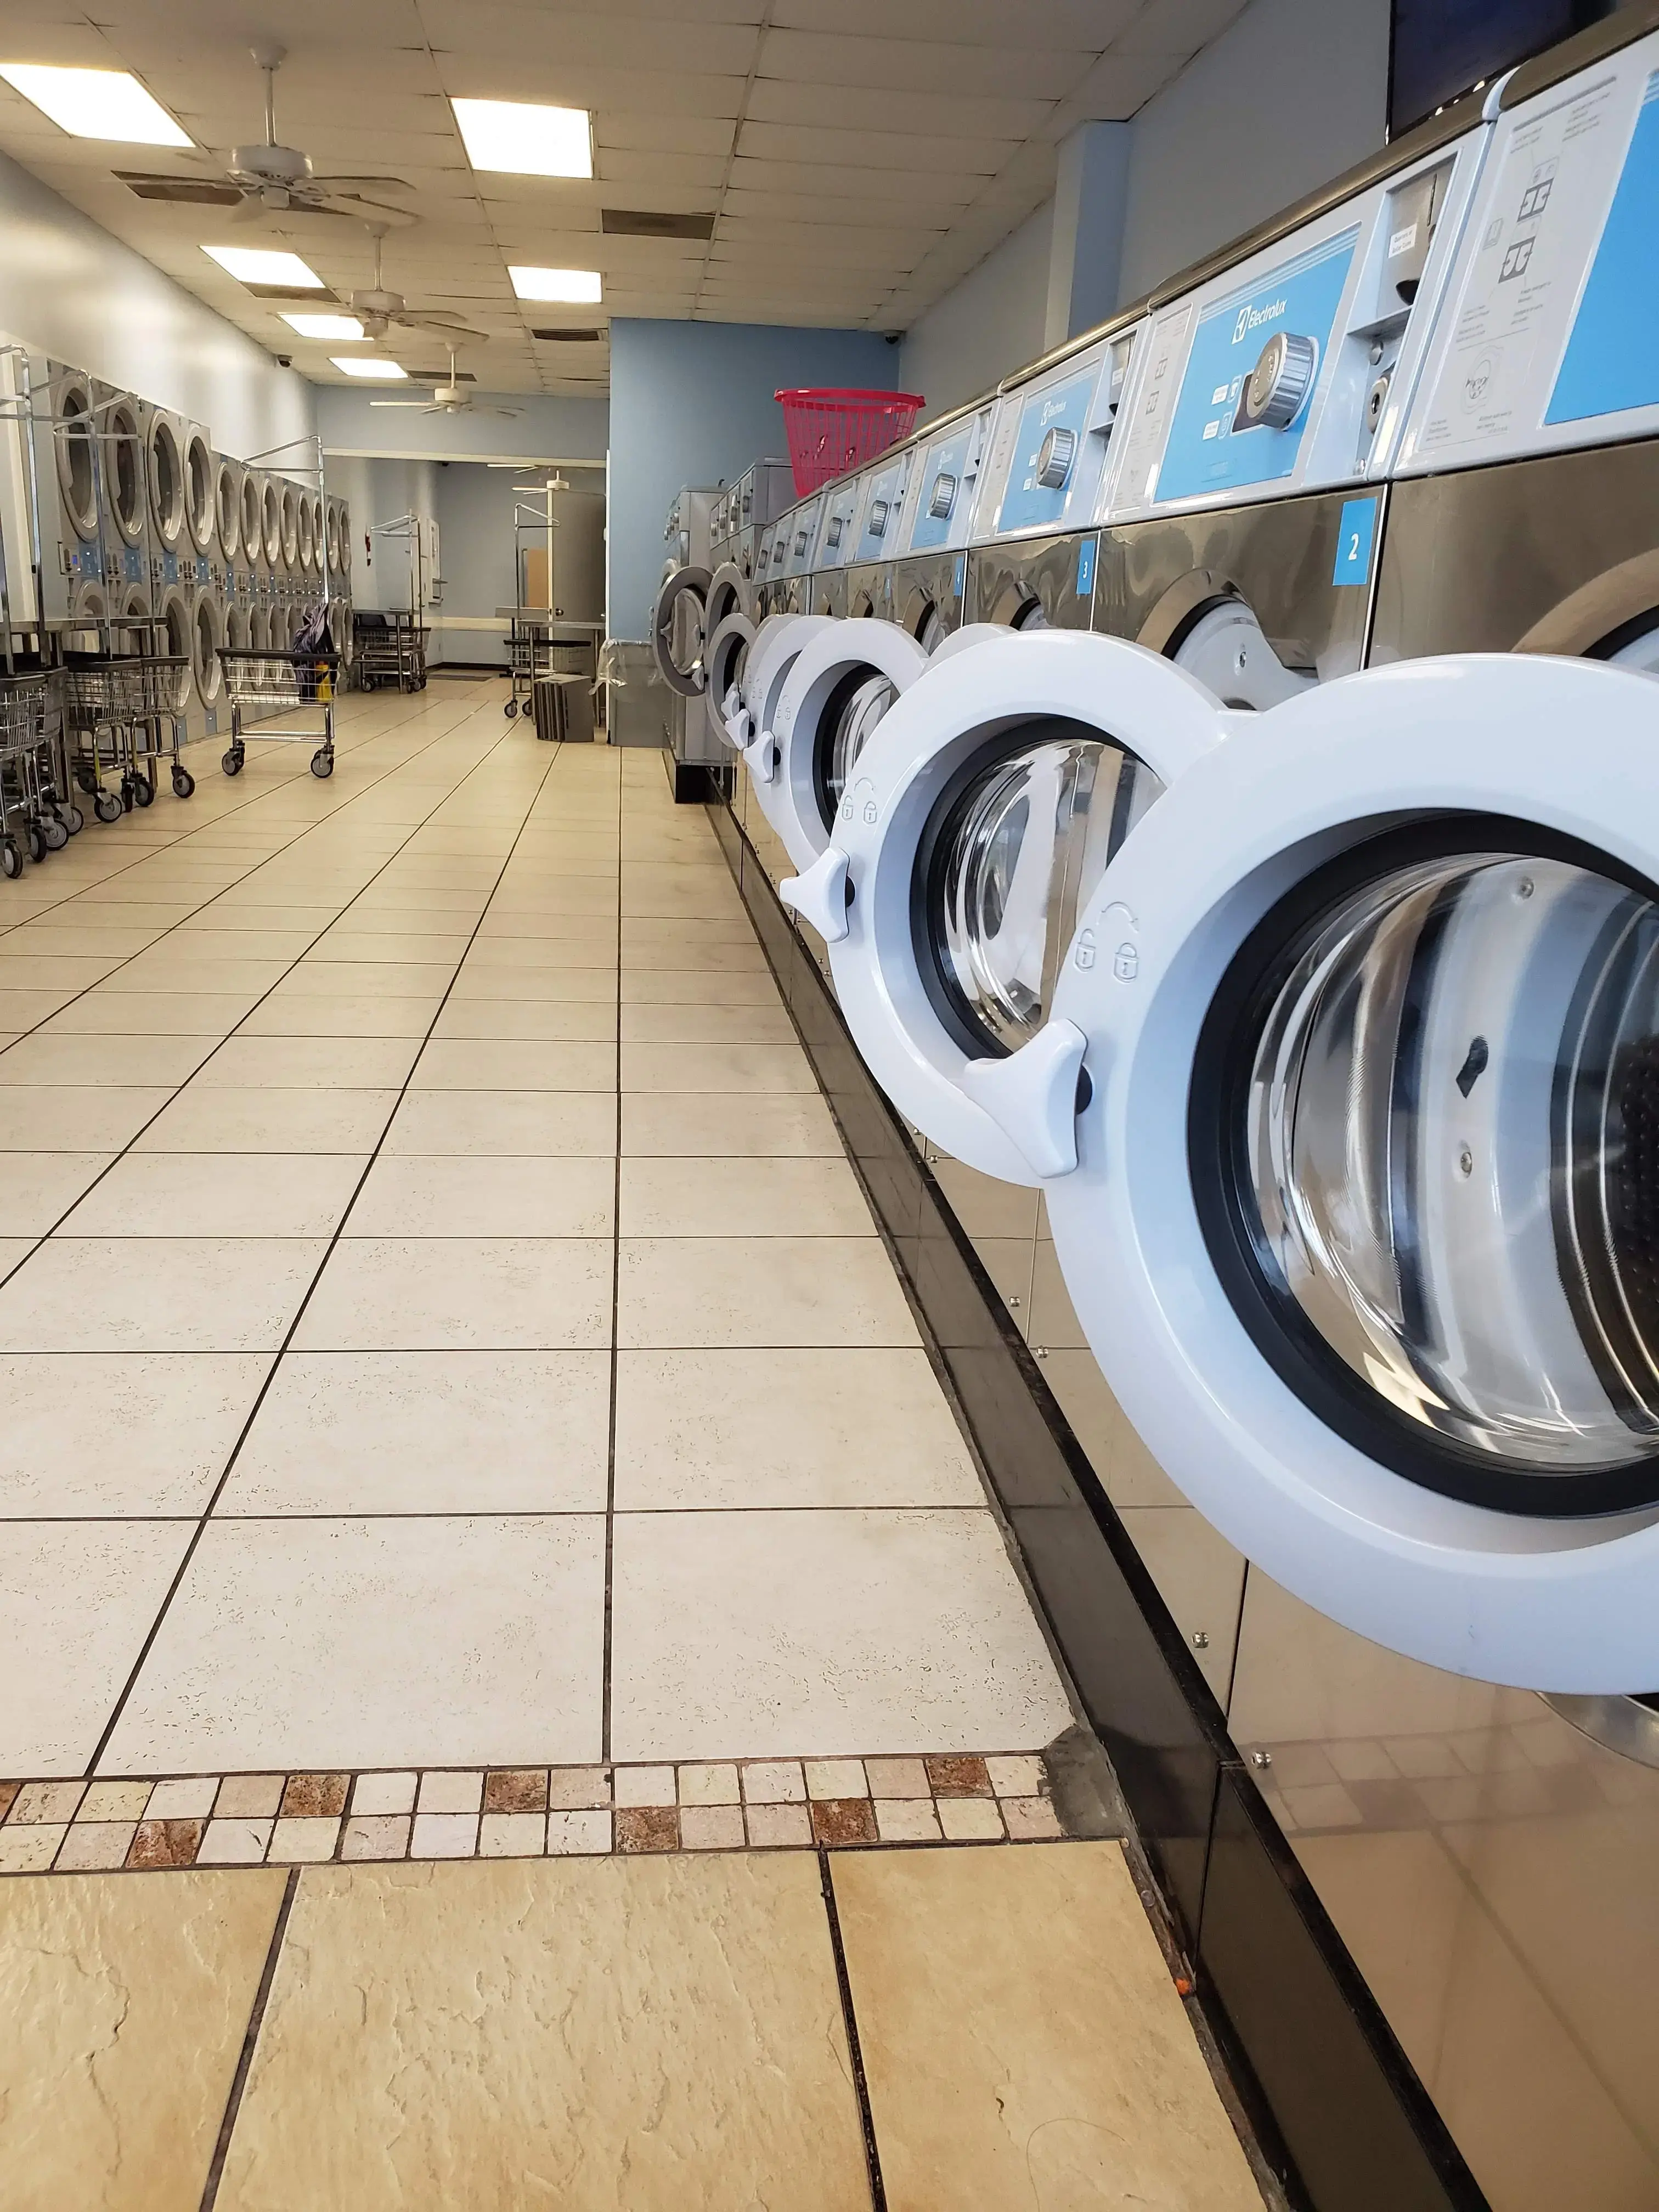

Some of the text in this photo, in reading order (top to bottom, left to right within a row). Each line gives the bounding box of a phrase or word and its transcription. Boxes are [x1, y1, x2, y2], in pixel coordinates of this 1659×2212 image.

[1248, 298, 1288, 329] Electrolux
[1348, 533, 1359, 560] 2
[1082, 560, 1088, 579] 3
